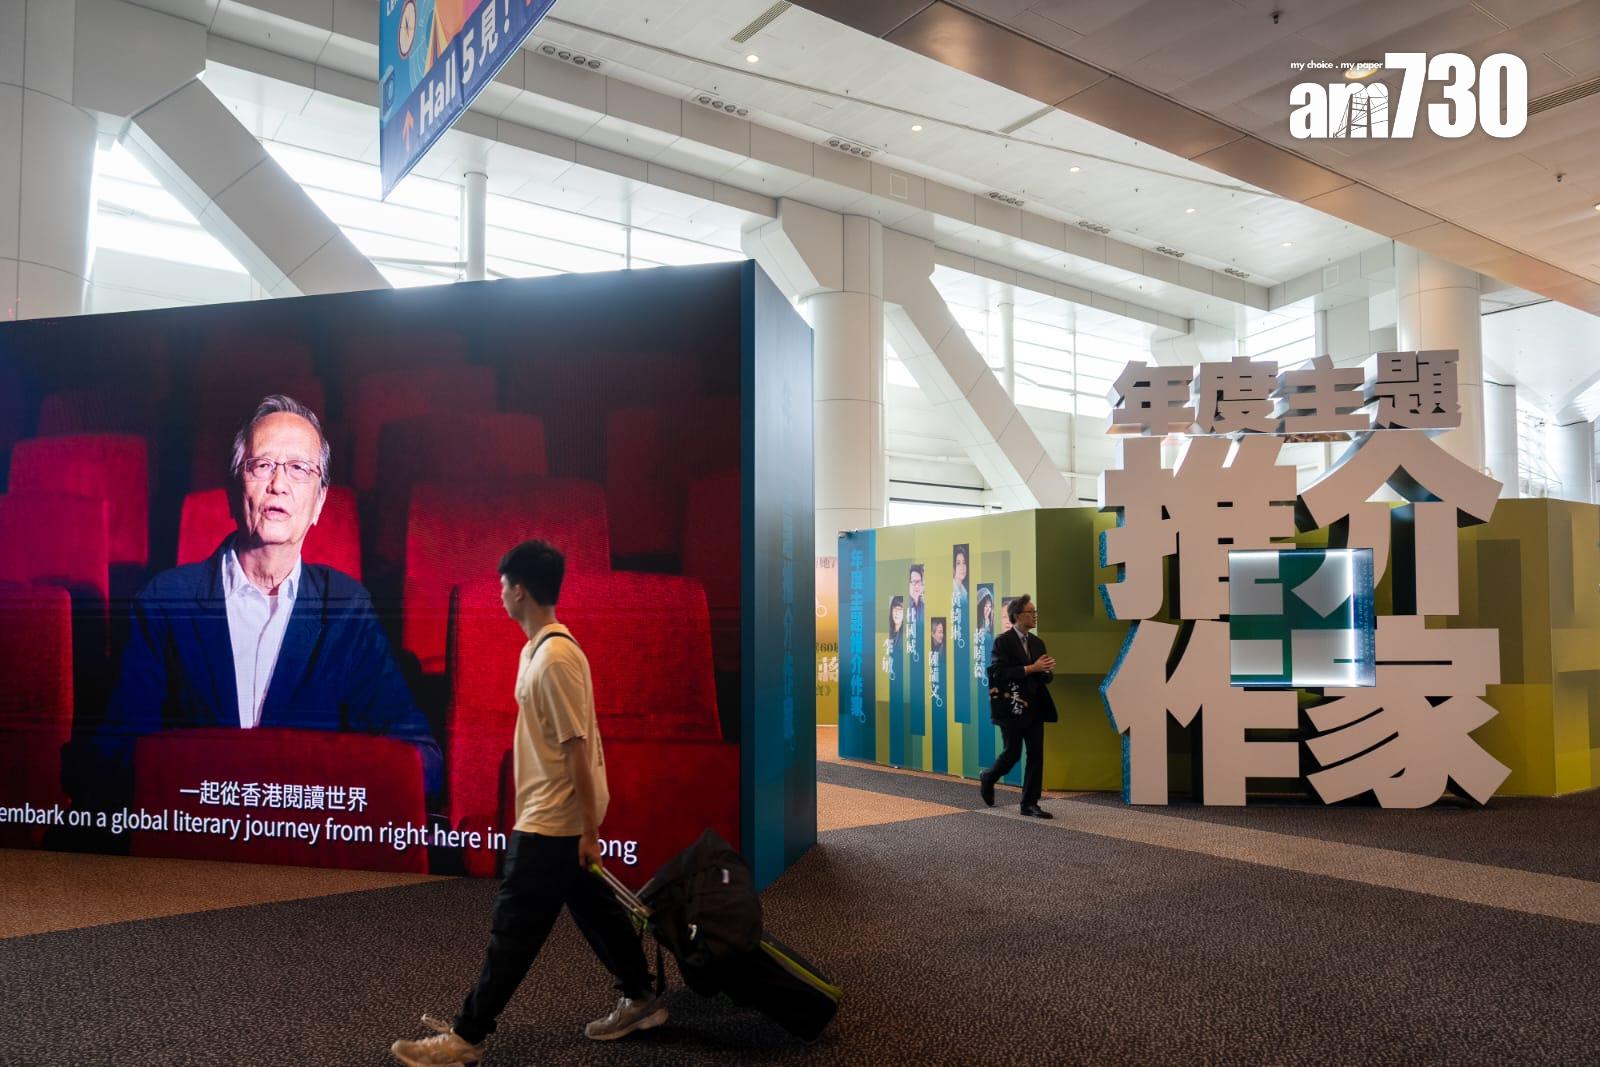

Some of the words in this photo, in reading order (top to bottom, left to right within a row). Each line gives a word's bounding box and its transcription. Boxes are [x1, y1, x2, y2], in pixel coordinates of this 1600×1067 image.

[420, 51, 457, 137] Hall
[462, 31, 476, 85] 5
[1106, 349, 1462, 435] 年度主題
[179, 780, 368, 812] 一起從香港閱讀世界
[0, 802, 64, 826] embark
[68, 810, 91, 827] on
[96, 811, 107, 828] a
[111, 807, 169, 834] global
[173, 809, 241, 841] literary
[243, 813, 321, 845] journey
[325, 817, 373, 843] from
[379, 821, 429, 851] right
[433, 823, 482, 849] here
[488, 826, 507, 851] in
[596, 837, 639, 865] ong
